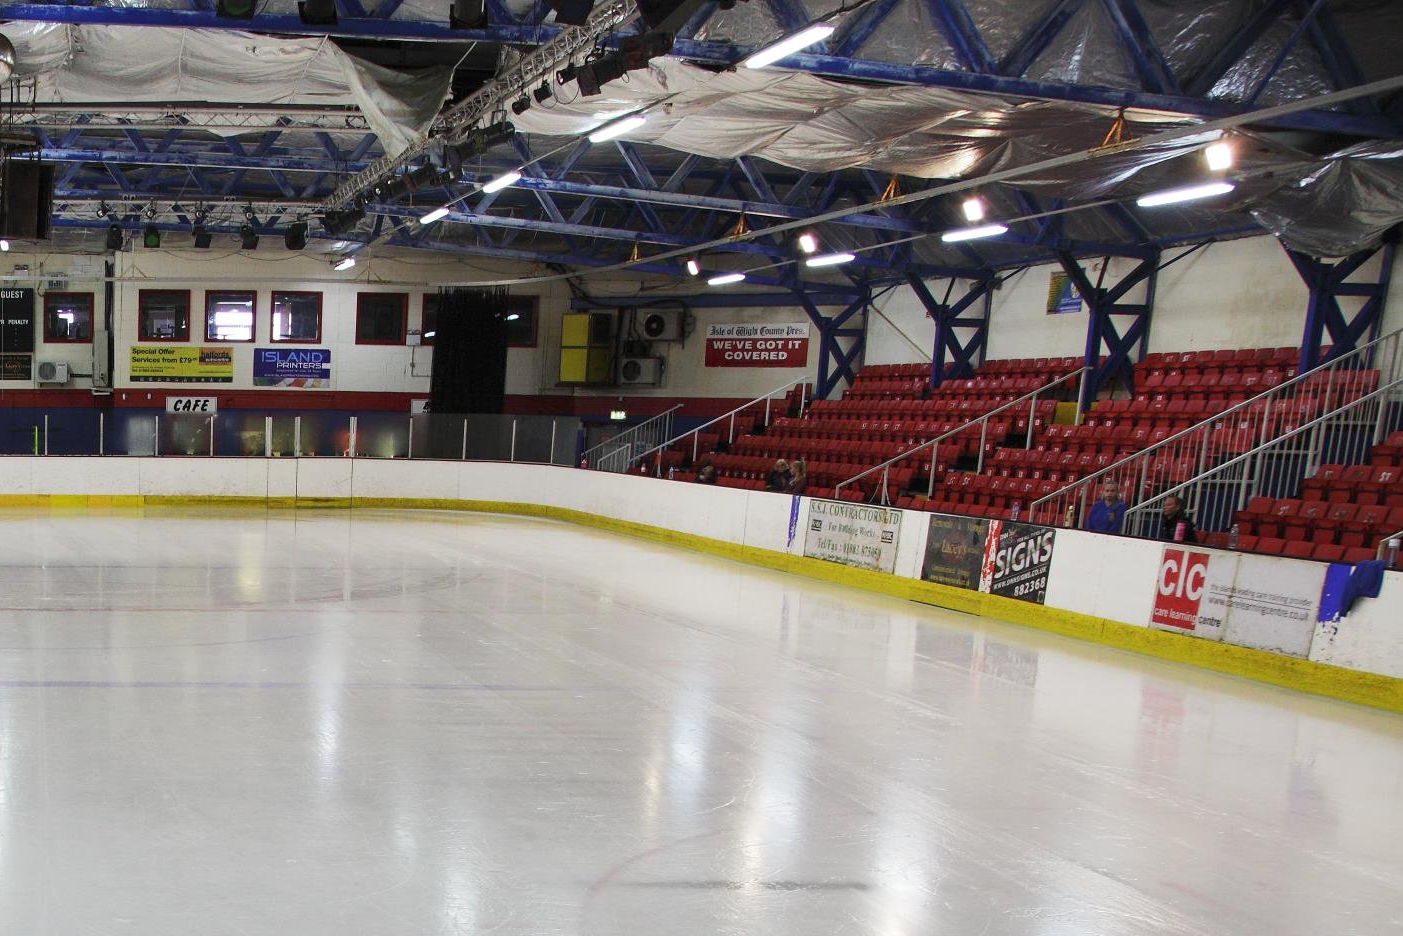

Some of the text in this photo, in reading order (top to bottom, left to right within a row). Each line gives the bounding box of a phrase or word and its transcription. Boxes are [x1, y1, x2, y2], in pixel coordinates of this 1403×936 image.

[0, 290, 24, 299] GUEST
[709, 325, 726, 336] Isle
[727, 325, 734, 336] of
[712, 340, 802, 350] WE'VE GOT IT
[132, 348, 157, 356] Special
[261, 351, 323, 362] ISLAND
[724, 351, 788, 360] COVERED
[161, 356, 177, 364] from
[173, 399, 210, 412] CAFE
[829, 504, 883, 522] CONTRACTORS
[994, 531, 1054, 579] SIGNS
[1013, 576, 1046, 597] 882368
[1154, 607, 1222, 628] care learning centre
